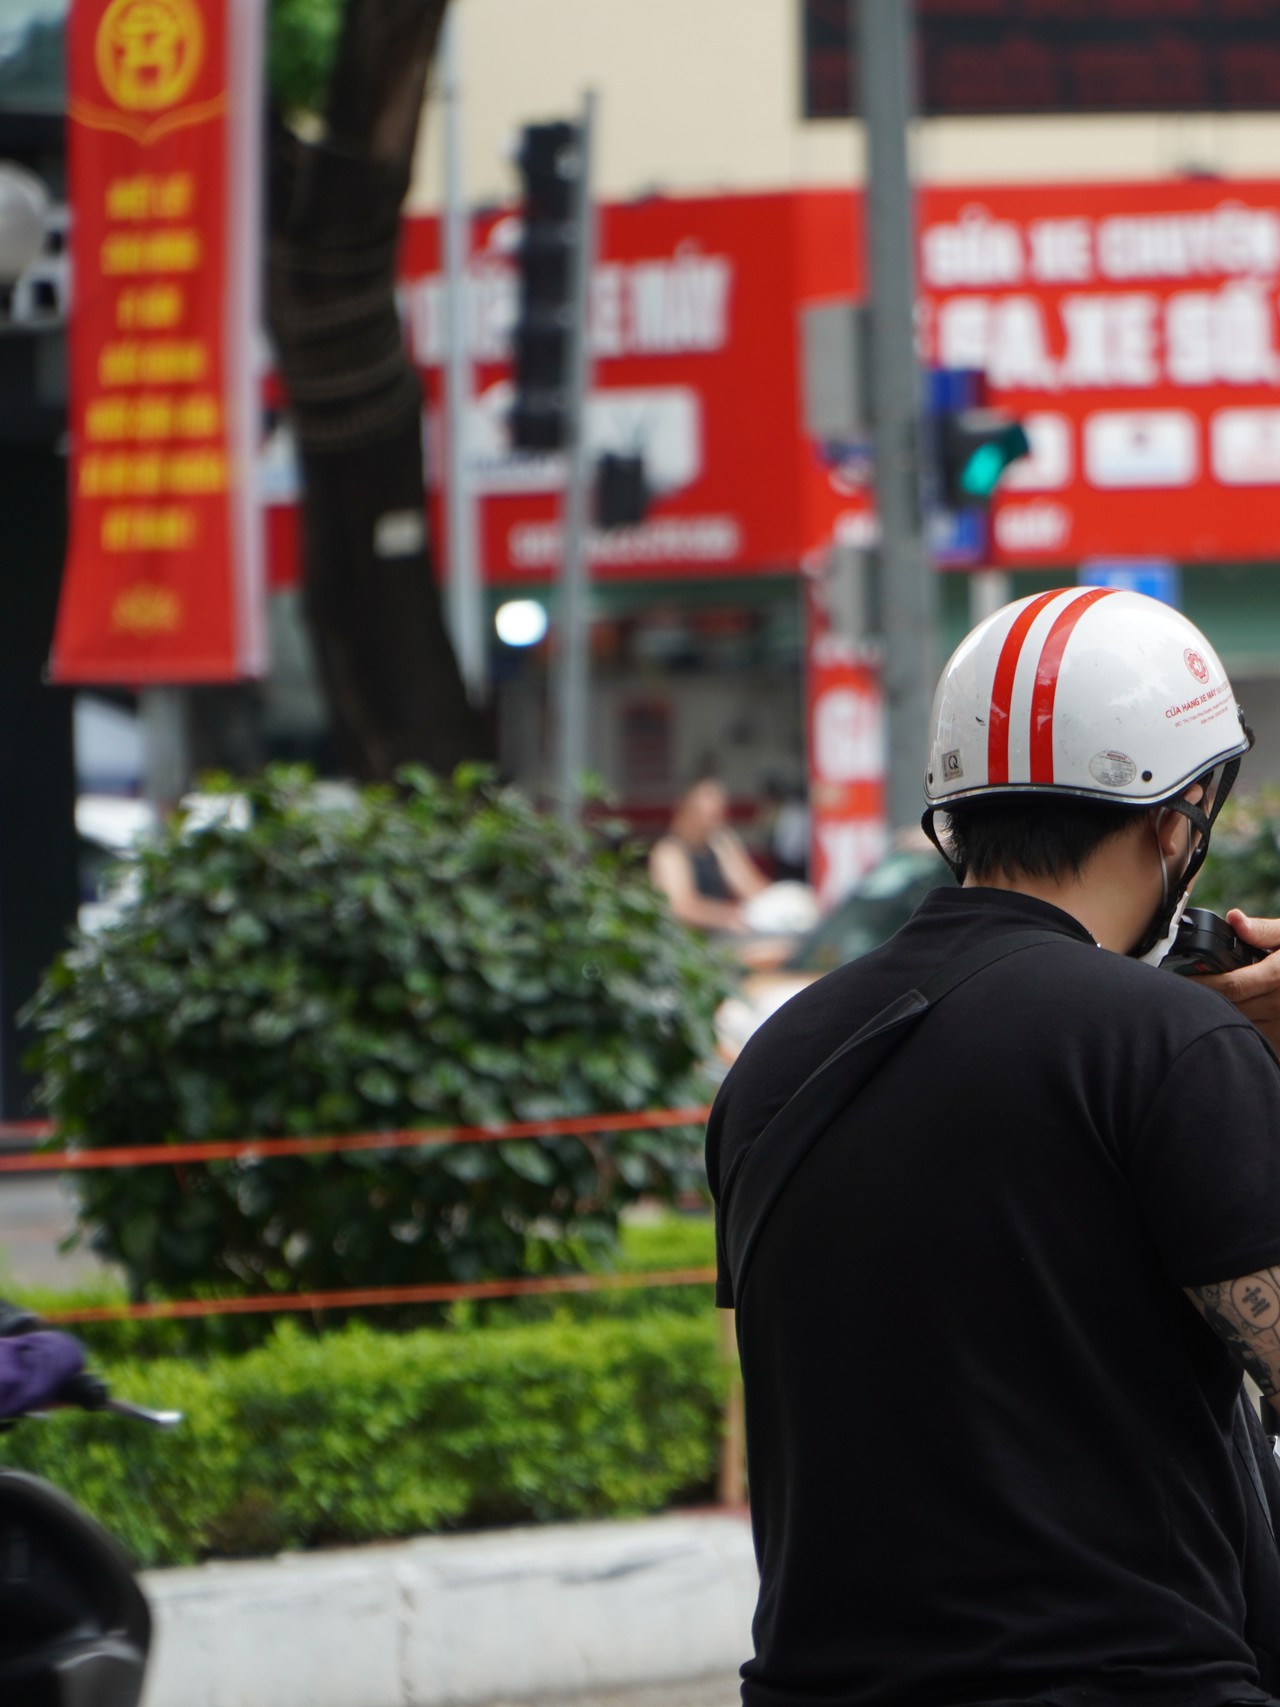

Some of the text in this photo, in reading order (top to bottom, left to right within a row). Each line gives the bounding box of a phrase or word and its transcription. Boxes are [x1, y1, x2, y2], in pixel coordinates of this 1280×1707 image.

[1030, 216, 1094, 283] XE
[1098, 199, 1280, 281] CHUYÊN
[1199, 693, 1208, 704] XE
